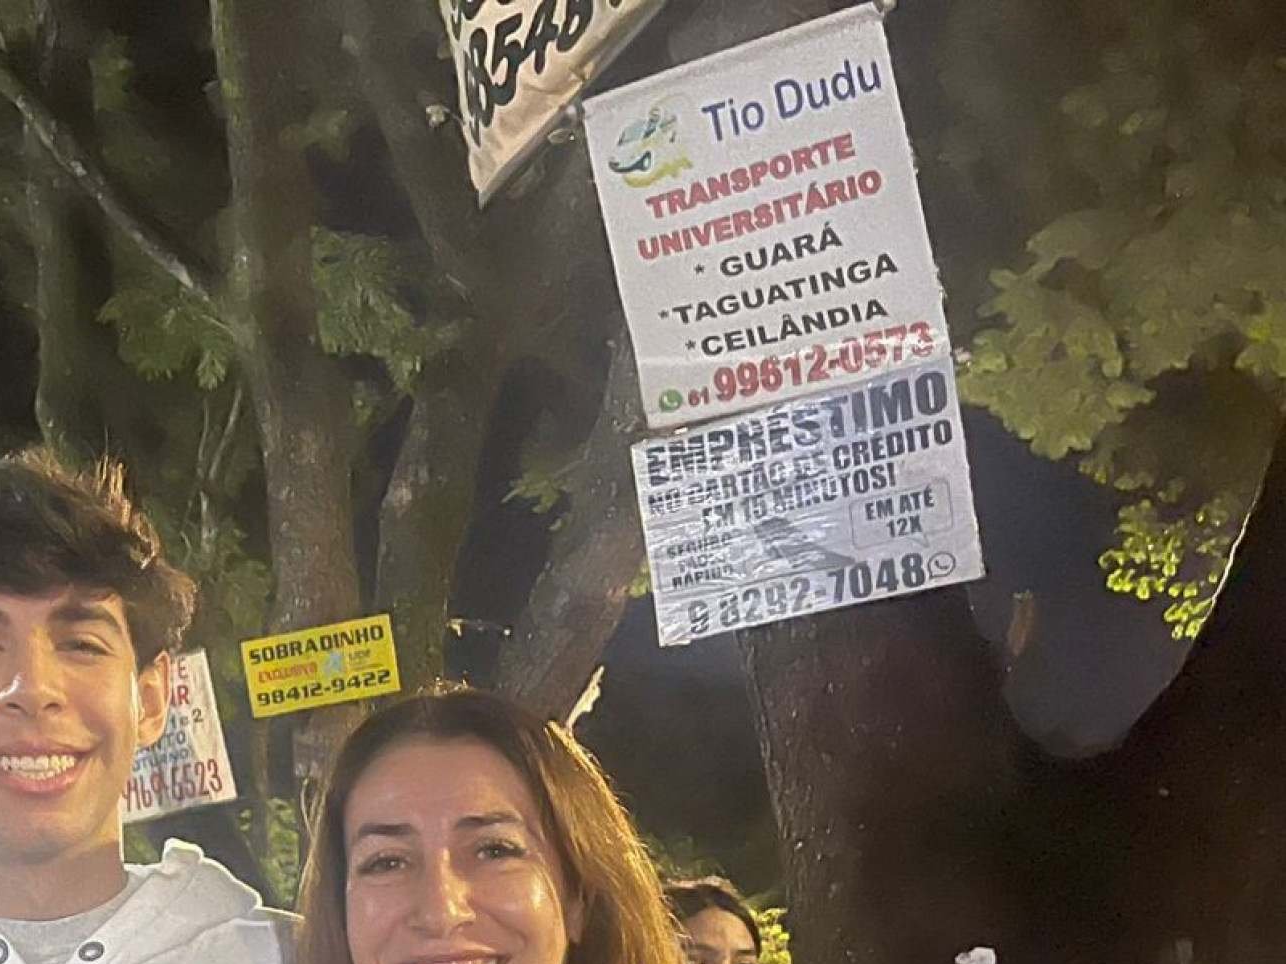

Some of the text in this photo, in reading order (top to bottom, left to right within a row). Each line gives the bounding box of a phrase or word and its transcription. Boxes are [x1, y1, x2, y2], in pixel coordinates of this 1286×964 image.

[701, 58, 881, 141] Tio Dudu
[646, 132, 856, 219] TRANSPORTE
[637, 170, 882, 260] UNIVERSITÁRIO
[720, 222, 842, 277] GUARÁ
[671, 253, 898, 324] TAGUATINGA
[700, 300, 888, 356] CEILÂNDIA
[688, 321, 933, 407] 61 99612-0573
[646, 371, 948, 488] EMPRÉSTIMO
[833, 420, 952, 471] CRÉDITO
[741, 492, 767, 525] 15
[864, 487, 935, 522] EM ATÉ
[886, 519, 924, 538] 12X
[249, 624, 384, 665] SOBRADINHO
[257, 669, 391, 706] 98412-9422
